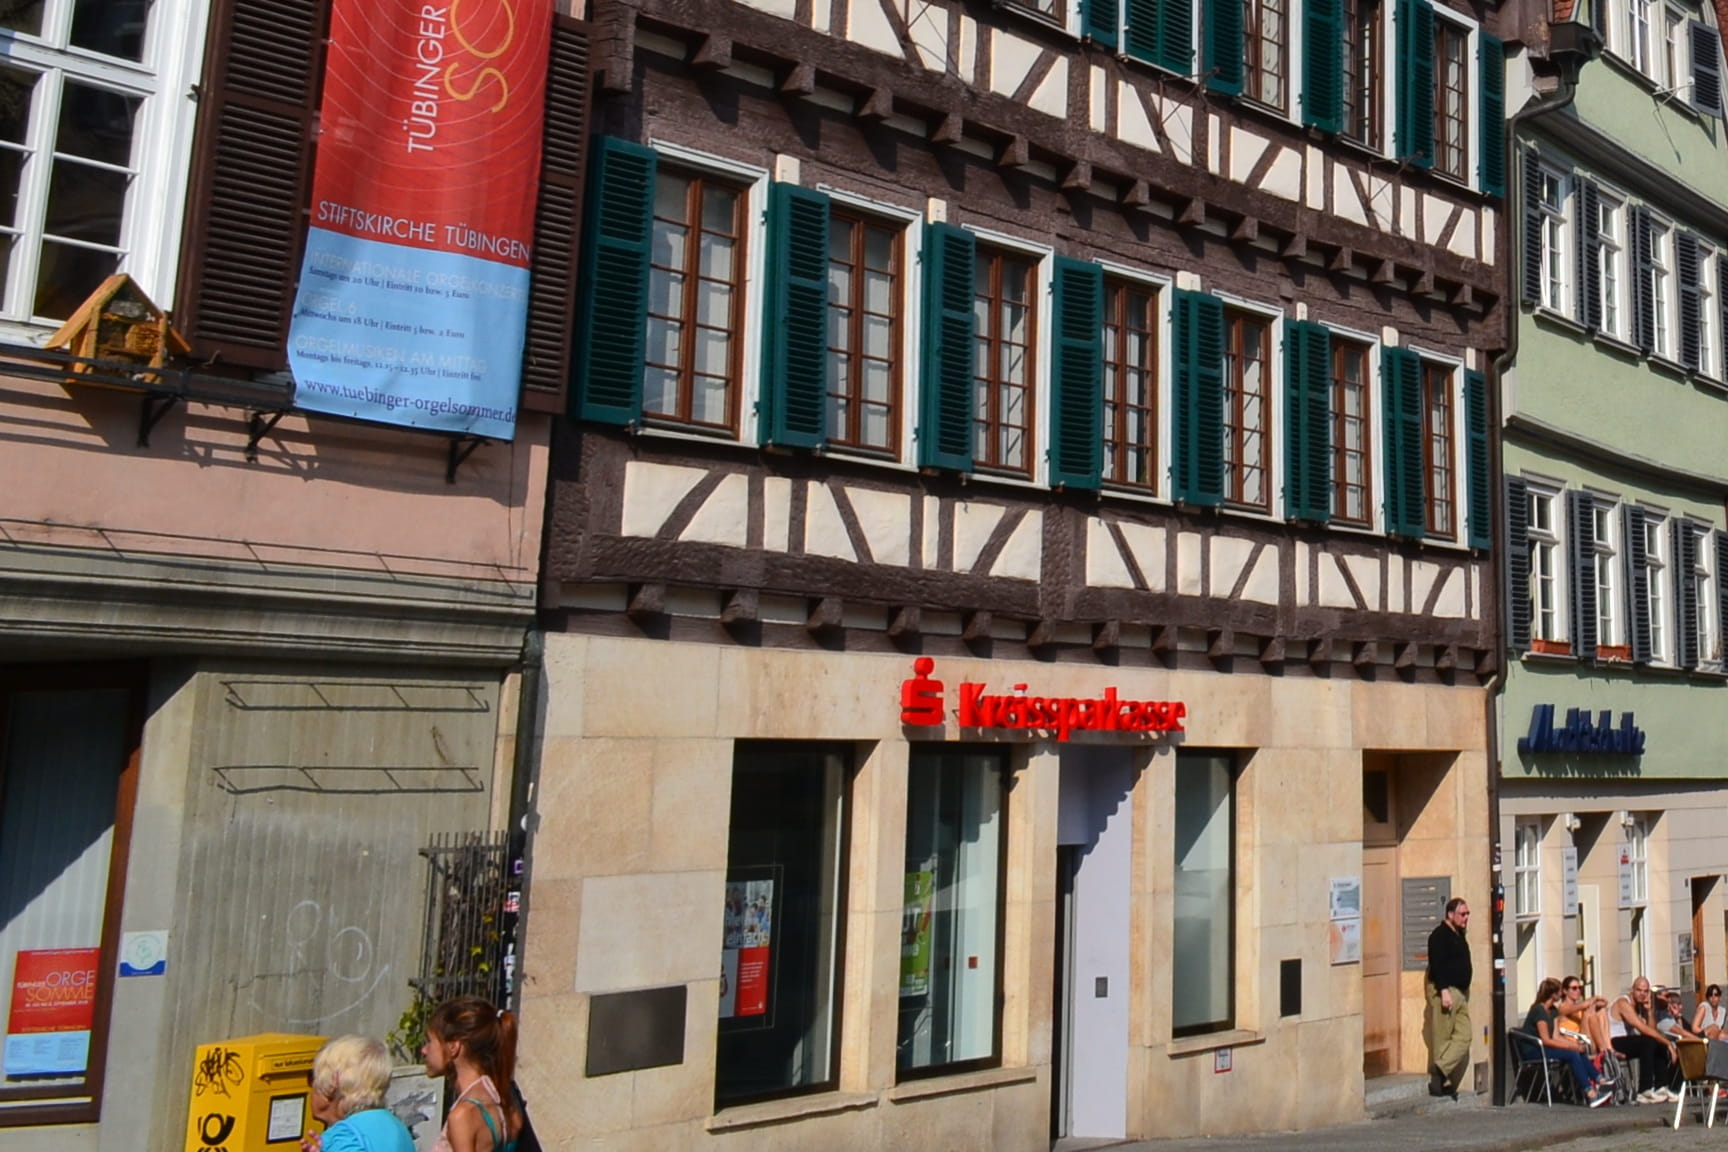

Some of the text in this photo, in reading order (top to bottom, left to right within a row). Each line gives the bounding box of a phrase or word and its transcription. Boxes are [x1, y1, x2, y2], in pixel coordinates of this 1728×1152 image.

[403, 4, 447, 153] TÜBINGER
[318, 200, 530, 261] STIFTSKIRCHE TÜBINGEN
